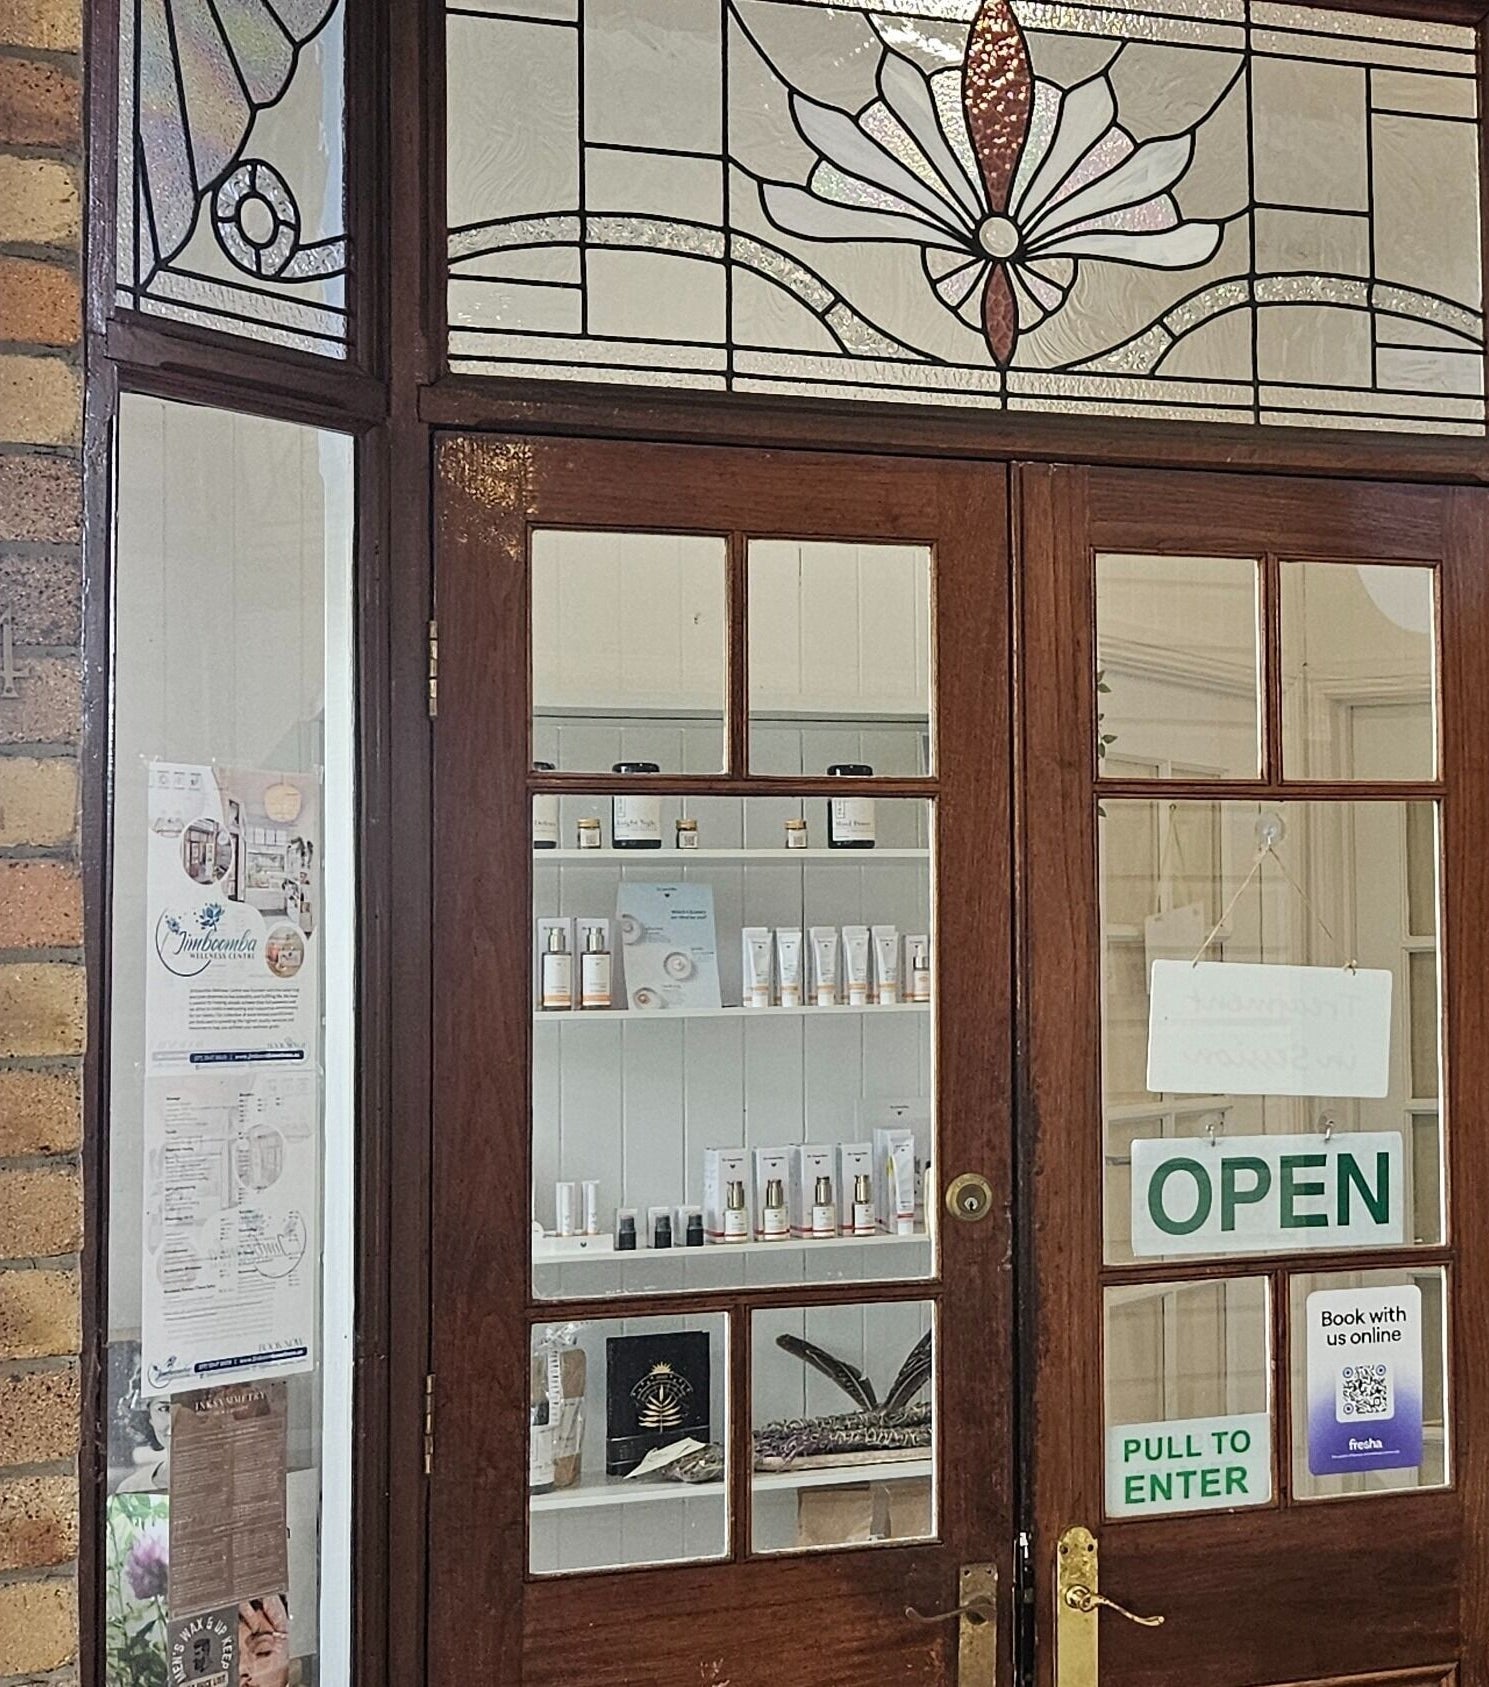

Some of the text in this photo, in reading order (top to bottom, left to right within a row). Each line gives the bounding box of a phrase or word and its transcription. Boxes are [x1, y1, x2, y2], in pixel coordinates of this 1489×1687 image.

[173, 929, 257, 955] Jimboomba
[190, 952, 226, 960] WELLNESS
[1147, 1151, 1390, 1236] OPEN
[1321, 1305, 1407, 1327] Book with
[1327, 1326, 1402, 1346] us online
[1124, 1429, 1251, 1463] PULL TO
[1348, 1438, 1383, 1451] fresha
[1125, 1466, 1249, 1504] ENTER
[179, 1617, 204, 1642] WAX
[214, 1619, 228, 1636] UP
[220, 1635, 233, 1670] KEEP
